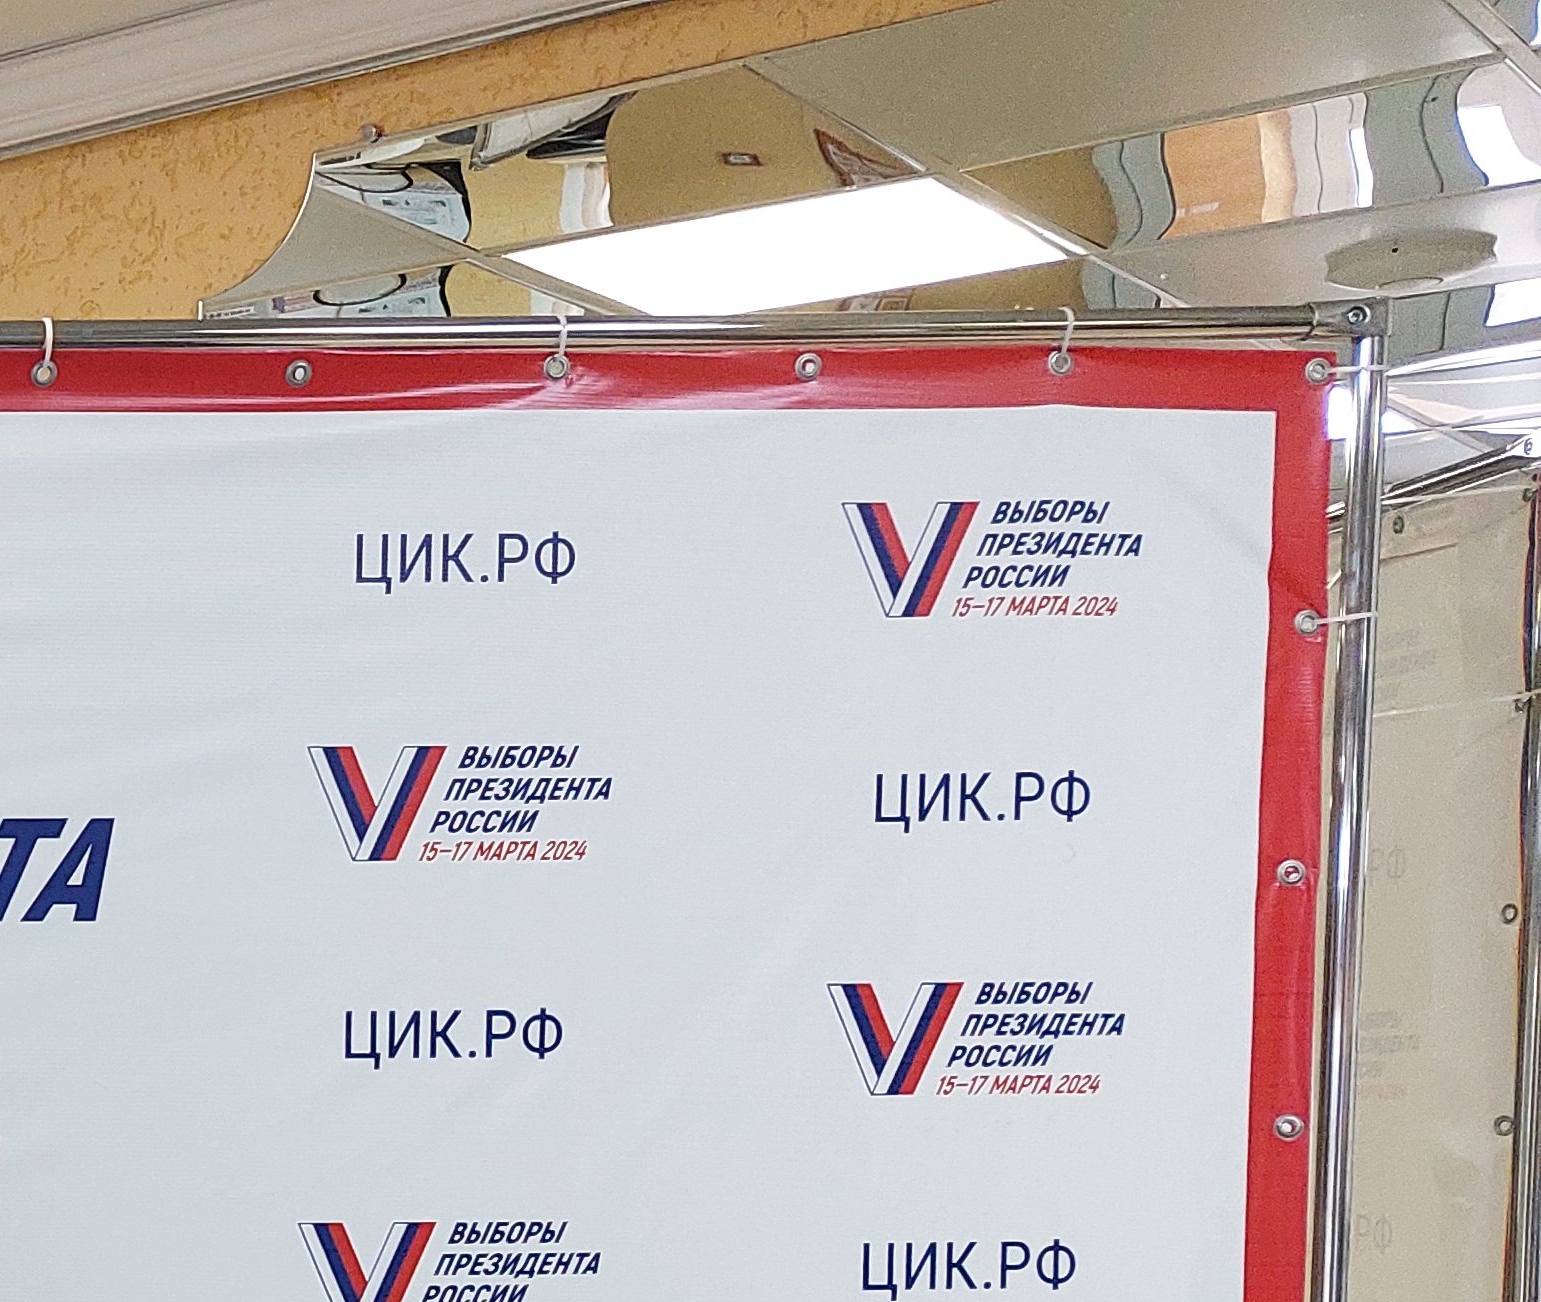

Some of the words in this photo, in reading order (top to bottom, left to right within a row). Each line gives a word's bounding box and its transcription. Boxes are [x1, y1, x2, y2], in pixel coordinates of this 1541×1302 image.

[990, 499, 1111, 525] ВЫБОРЫ
[975, 531, 1143, 559] ПРЕЗИДЕНТА
[355, 530, 576, 595] ЦИК.РФ
[961, 564, 1071, 589] РОССИИ
[1005, 595, 1071, 617] МАРТА
[1071, 595, 1119, 617] 2024
[457, 745, 580, 769] ВЫБОРЫ
[443, 777, 613, 805] ПРЕЗИДЕНТА
[874, 769, 1091, 834] ЦИК.РФ
[428, 809, 540, 834] РОССИИ
[472, 840, 539, 861] МАРТА
[539, 840, 588, 861] 2024
[974, 981, 1094, 1006] ВЫБОРЫ
[960, 1012, 1126, 1040] ПРЕЗИДЕНТА
[344, 1007, 563, 1071] ЦИК.РФ
[945, 1044, 1054, 1068] РОССИИ
[988, 1074, 1053, 1095] МАРТА
[1054, 1074, 1101, 1094] 2024
[447, 1220, 569, 1245] ВЫБОРЫ
[433, 1251, 602, 1279] ПРЕЗИДЕНТА
[862, 1238, 1076, 1302] ЦИК.РФ
